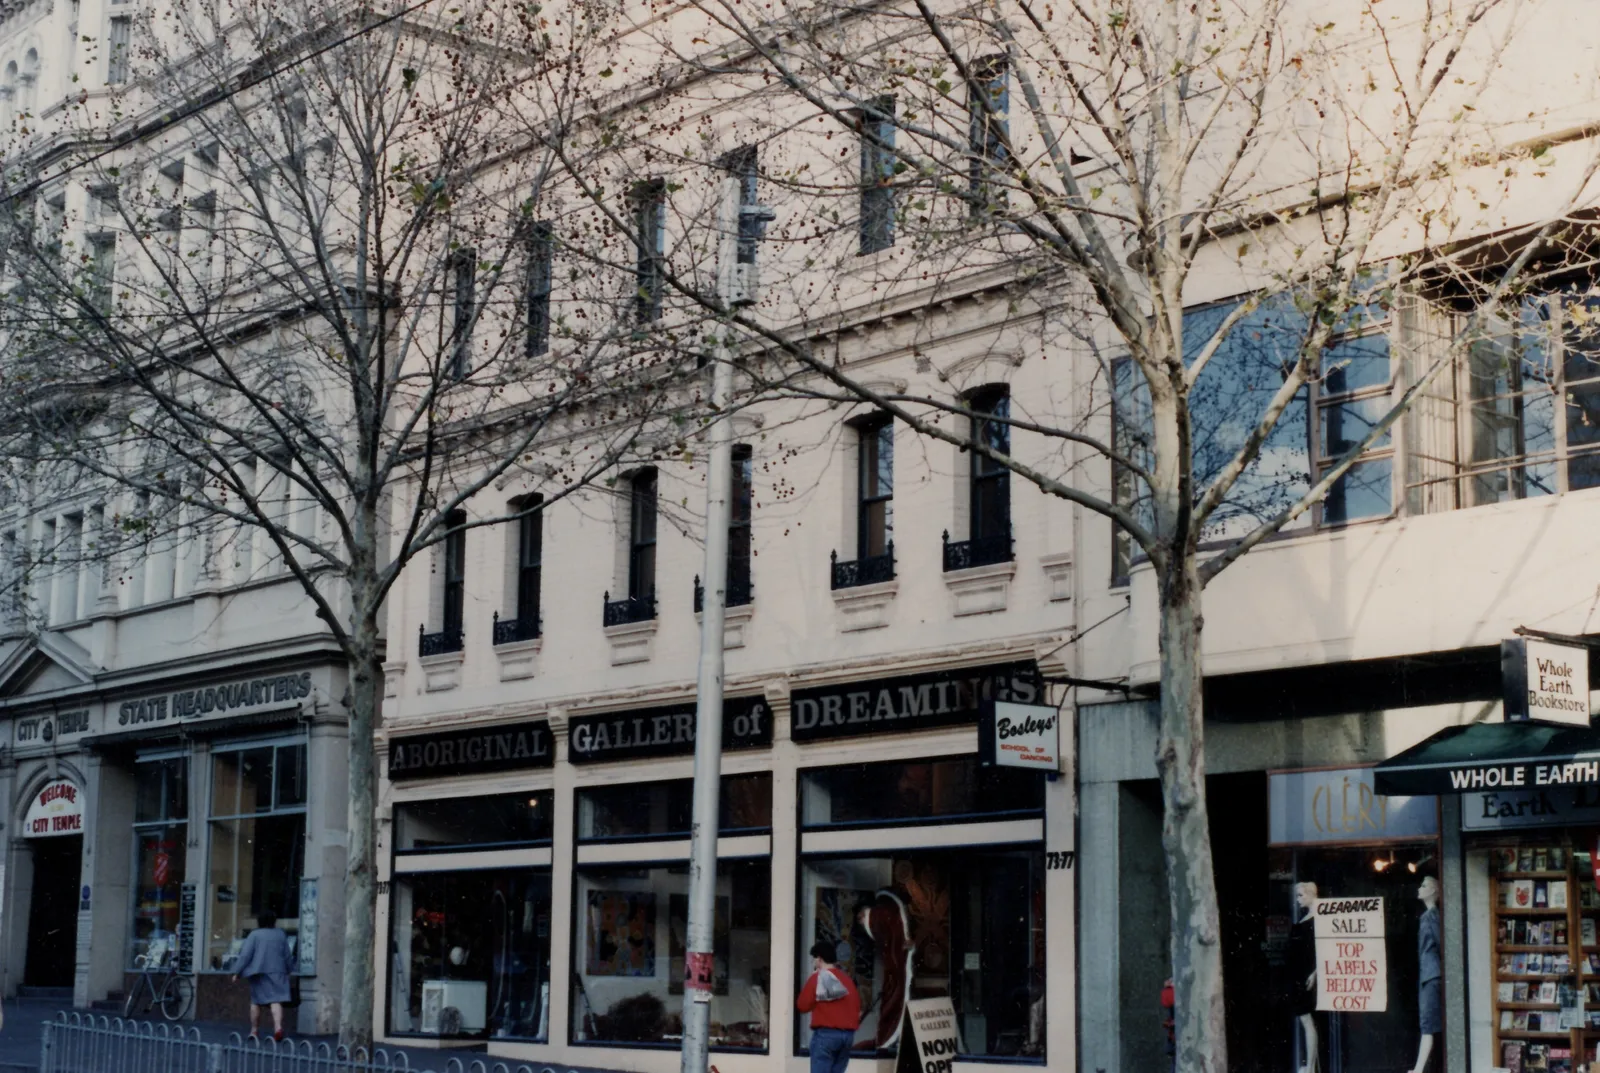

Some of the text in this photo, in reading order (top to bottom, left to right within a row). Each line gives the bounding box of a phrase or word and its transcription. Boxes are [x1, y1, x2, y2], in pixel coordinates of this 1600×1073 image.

[1536, 657, 1573, 677] Whole
[1539, 675, 1573, 695] Earth
[118, 671, 312, 726] STATE HEADQUARTERS
[1528, 690, 1586, 712] Bookstore
[18, 709, 90, 742] CITY TEMPLE
[390, 671, 1037, 771] ABORIGINAL GALLER of DREAMINGS
[1450, 761, 1598, 789] WHOLE EARTH
[39, 783, 77, 807] WELCOME
[32, 813, 82, 833] CITY TEMPLE
[1317, 898, 1380, 916] CLEARANCE
[1331, 918, 1367, 933] SALE
[1336, 943, 1364, 958] TOP
[1324, 960, 1378, 975] LABELS
[1326, 978, 1376, 992] BELOW
[1332, 996, 1371, 1010] COST
[921, 1037, 957, 1057] NOW
[925, 1059, 953, 1073] OPE
